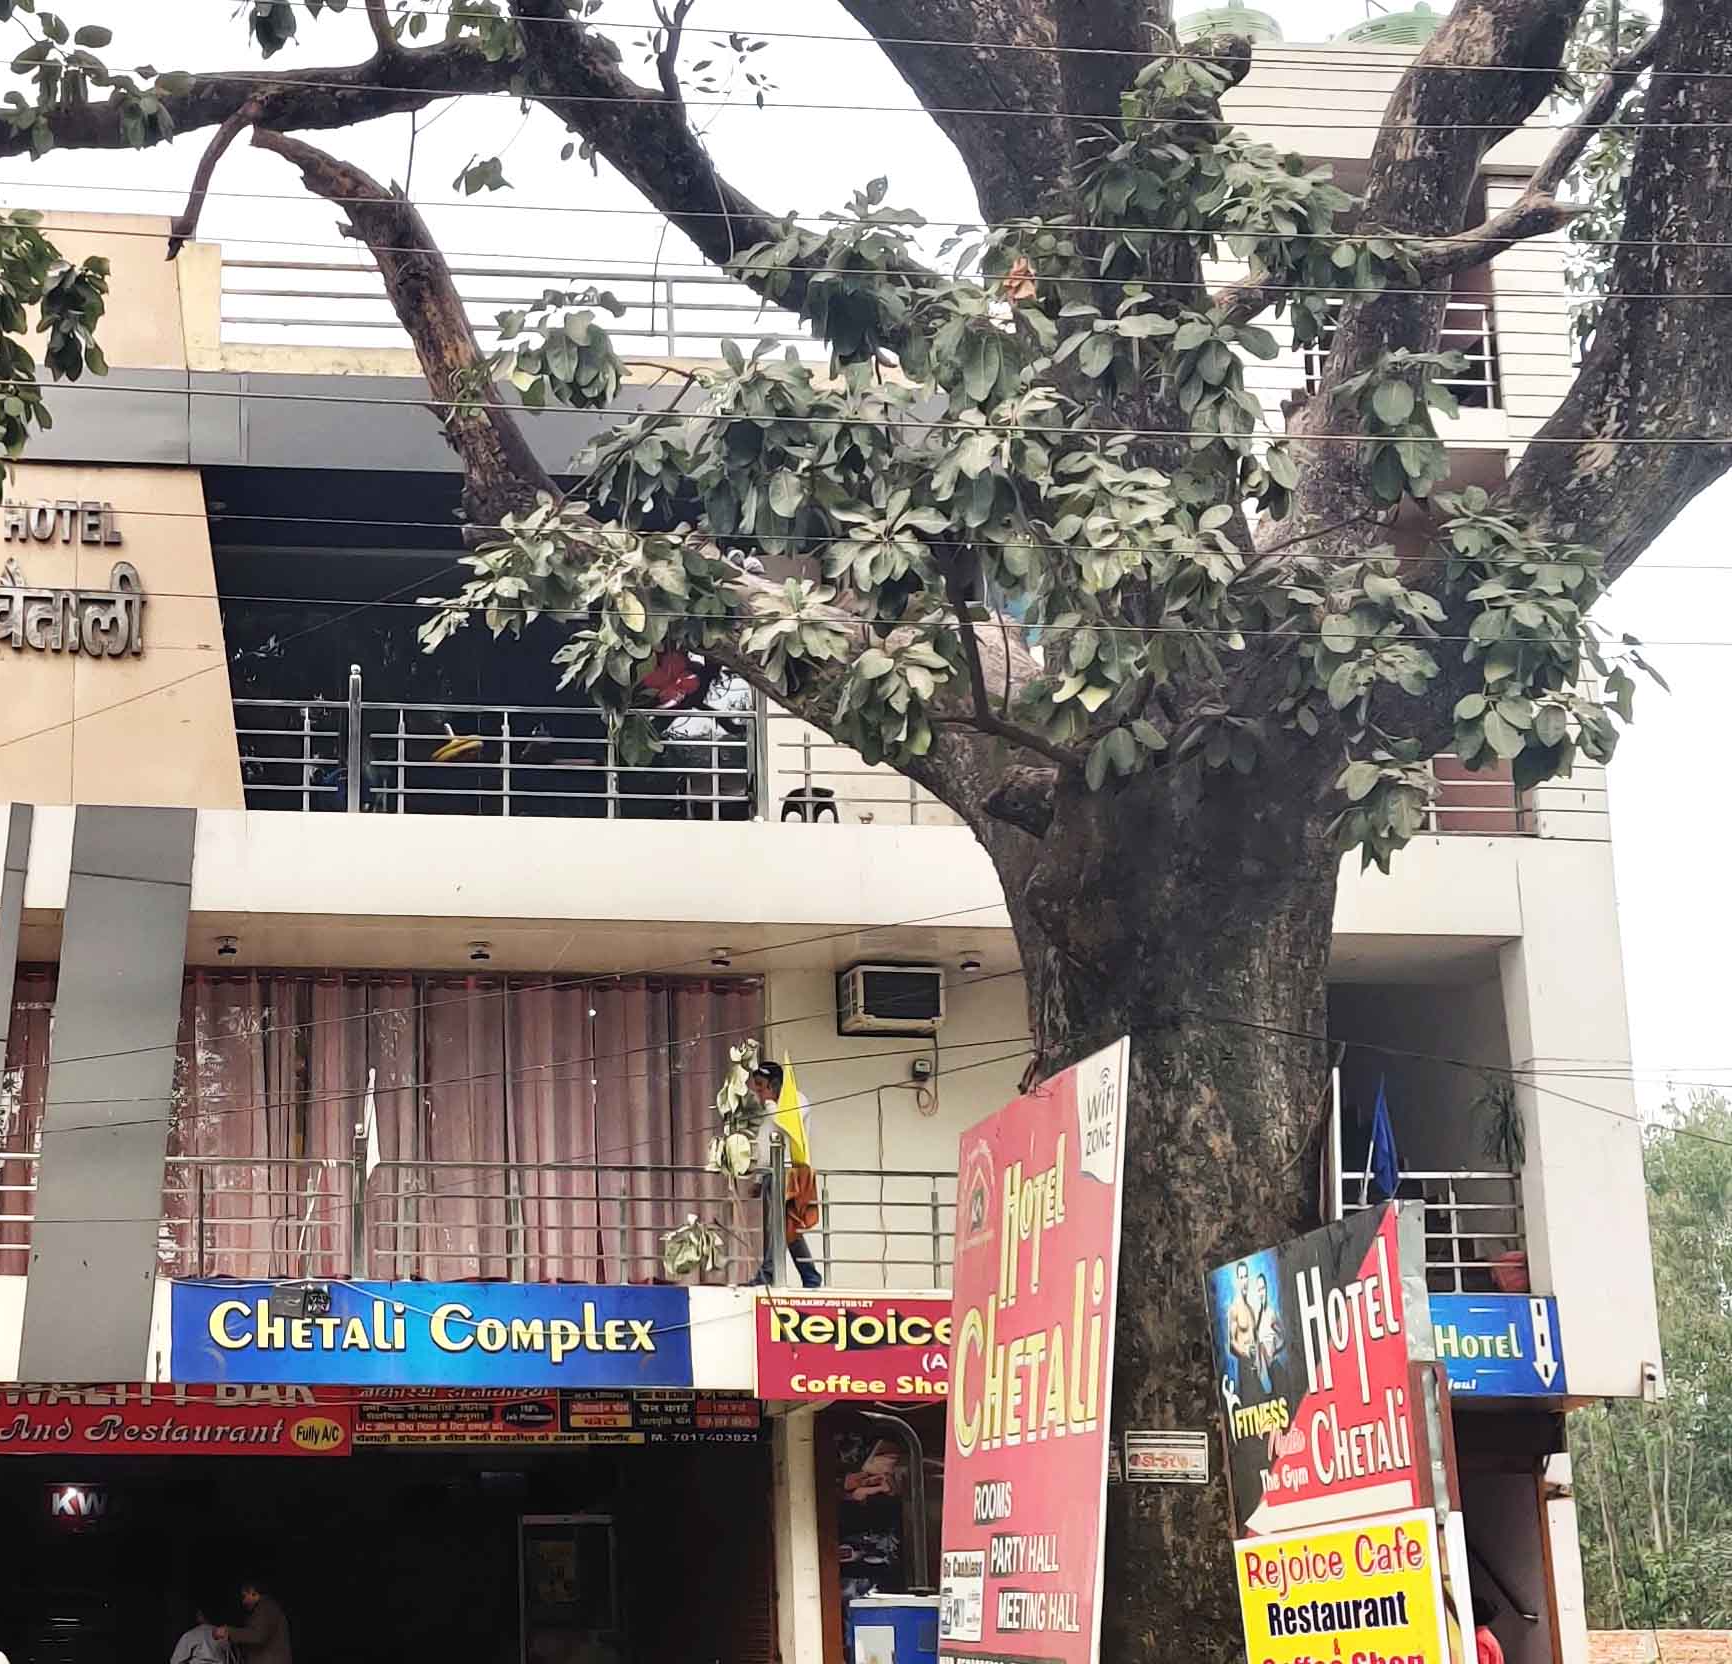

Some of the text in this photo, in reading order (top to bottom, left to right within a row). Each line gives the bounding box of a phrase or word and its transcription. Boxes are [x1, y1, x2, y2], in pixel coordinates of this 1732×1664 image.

[4, 498, 123, 546] HOTEL
[1086, 1083, 1116, 1125] Wifi
[1085, 1121, 1113, 1157] ZONE
[790, 1374, 950, 1395] Coffee Sho
[84, 1413, 286, 1443] Restaurant
[295, 1420, 340, 1442] Fully A/C
[1235, 1396, 1290, 1440] FITNESS
[1259, 1463, 1309, 1495] The Gym
[973, 1480, 1013, 1522] ROOMS
[991, 1535, 1060, 1575] PARTY HALL
[1246, 1528, 1425, 1598] Rejoice Cafe
[997, 1591, 1046, 1631] MEETING
[1047, 1591, 1081, 1633] HALL
[1267, 1590, 1409, 1639] Restaurant
